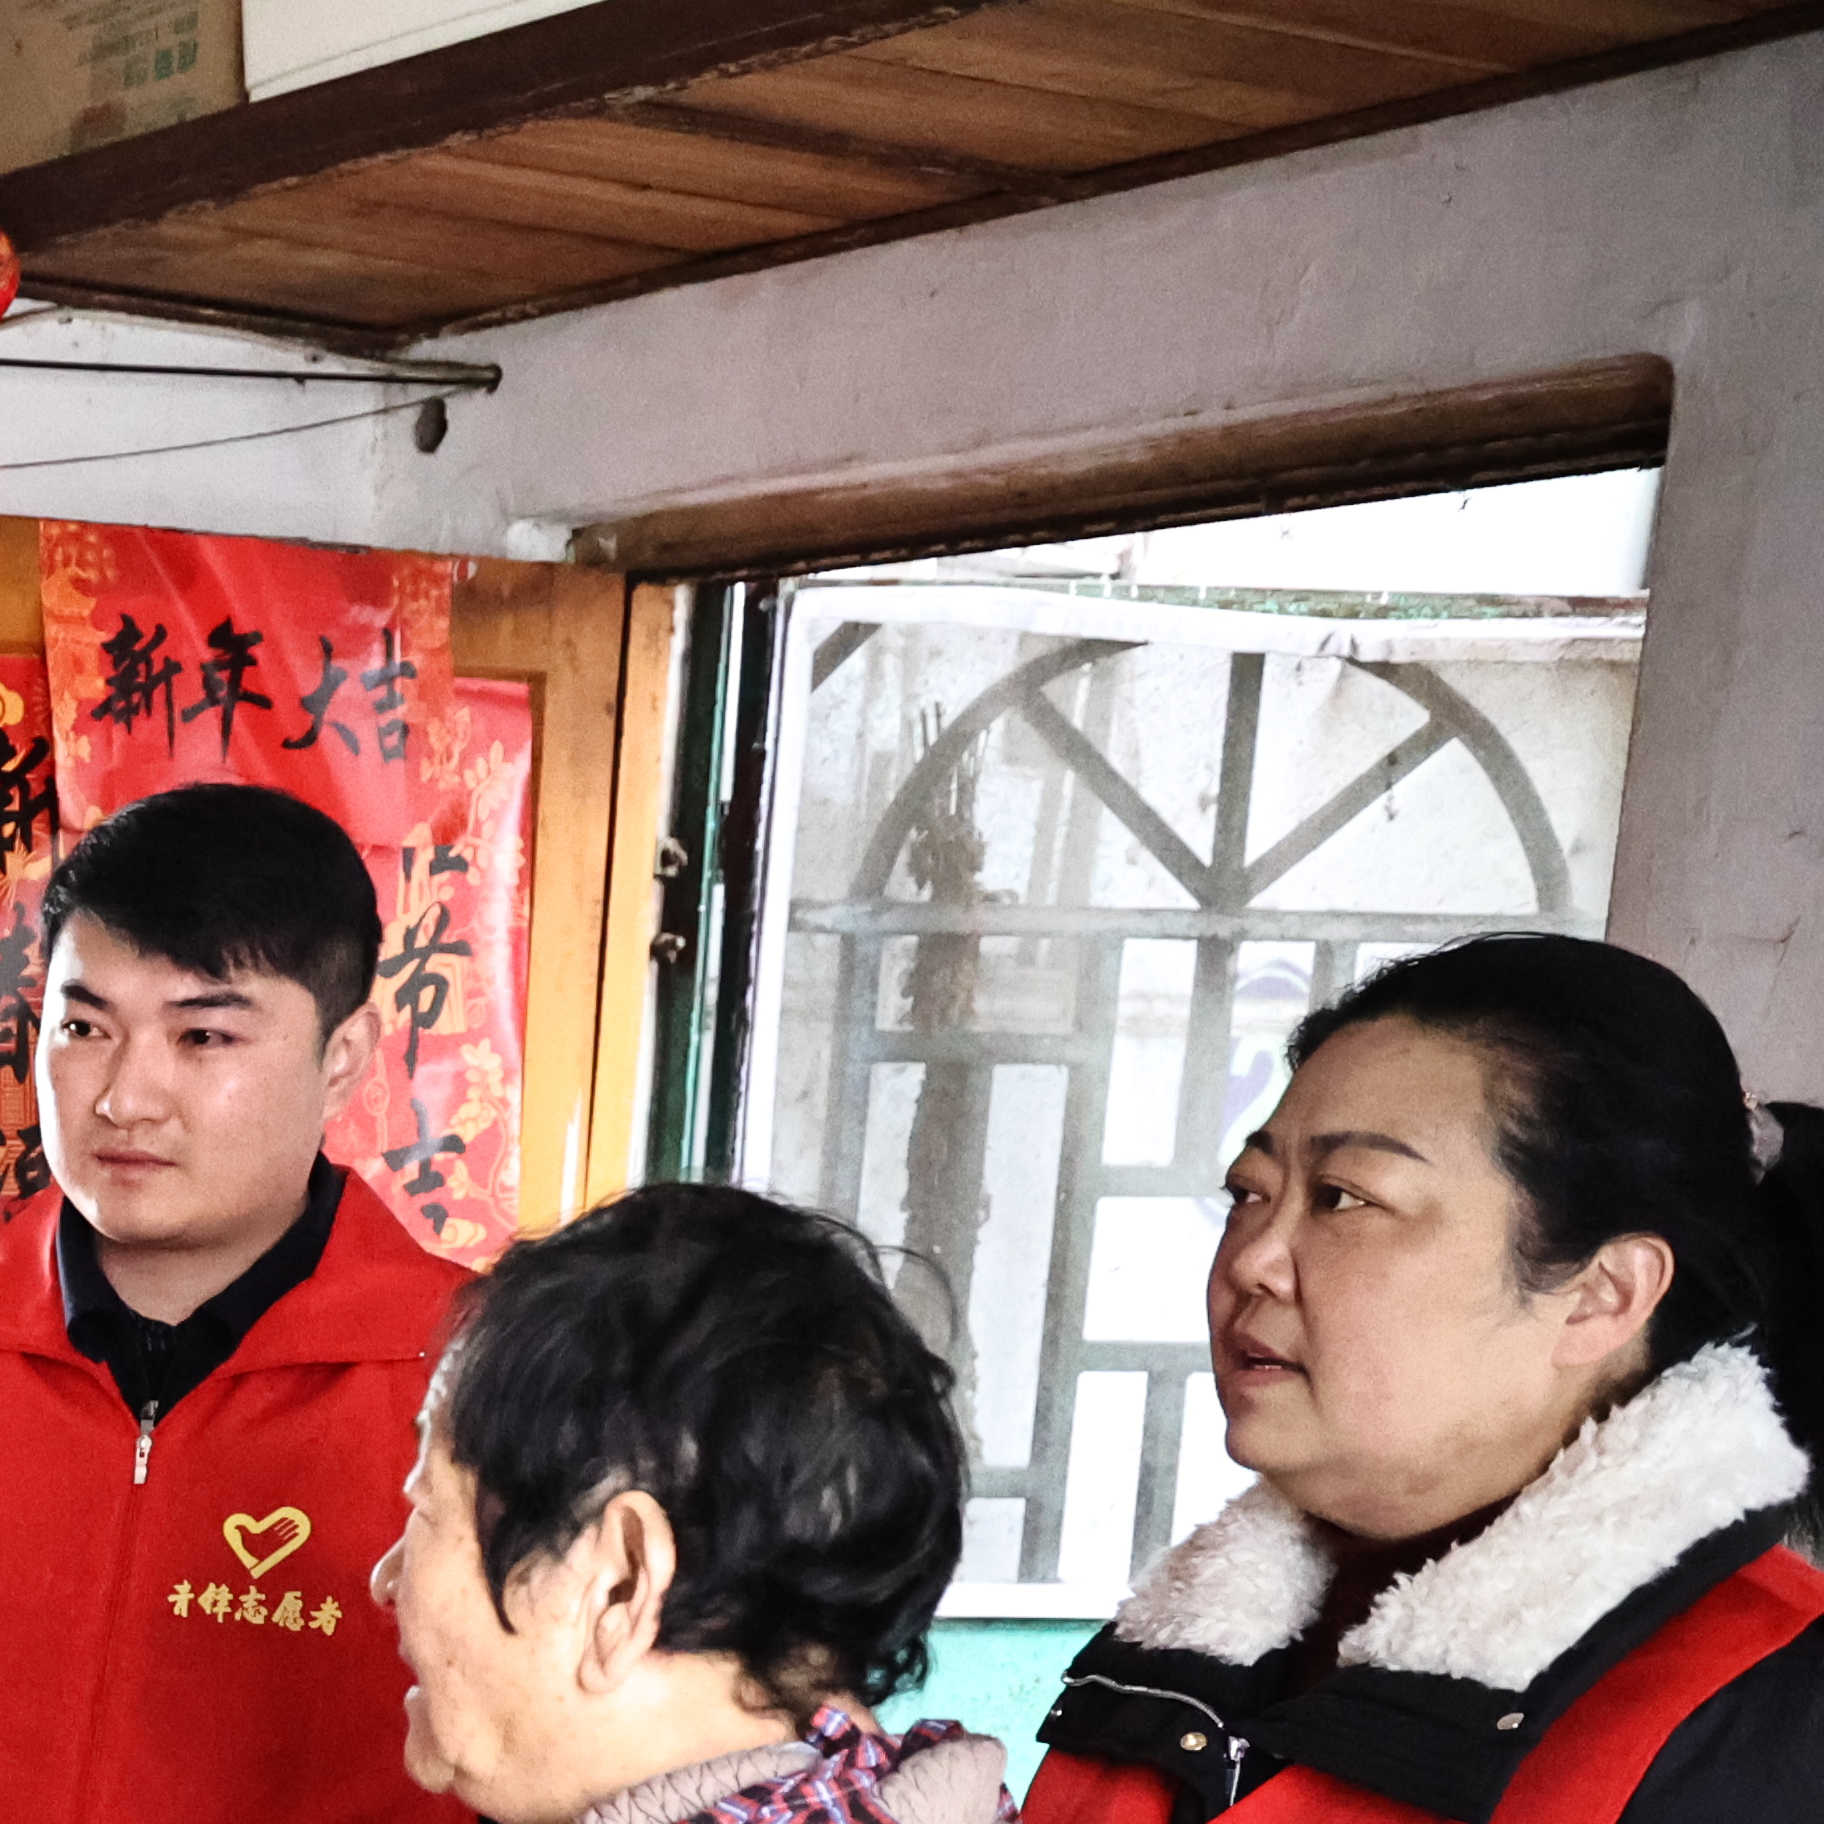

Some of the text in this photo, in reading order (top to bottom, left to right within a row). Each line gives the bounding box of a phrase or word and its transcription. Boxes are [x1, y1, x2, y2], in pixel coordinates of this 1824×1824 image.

[91, 613, 418, 764] 新年大吉
[167, 1579, 343, 1637] 青锋志愿者
